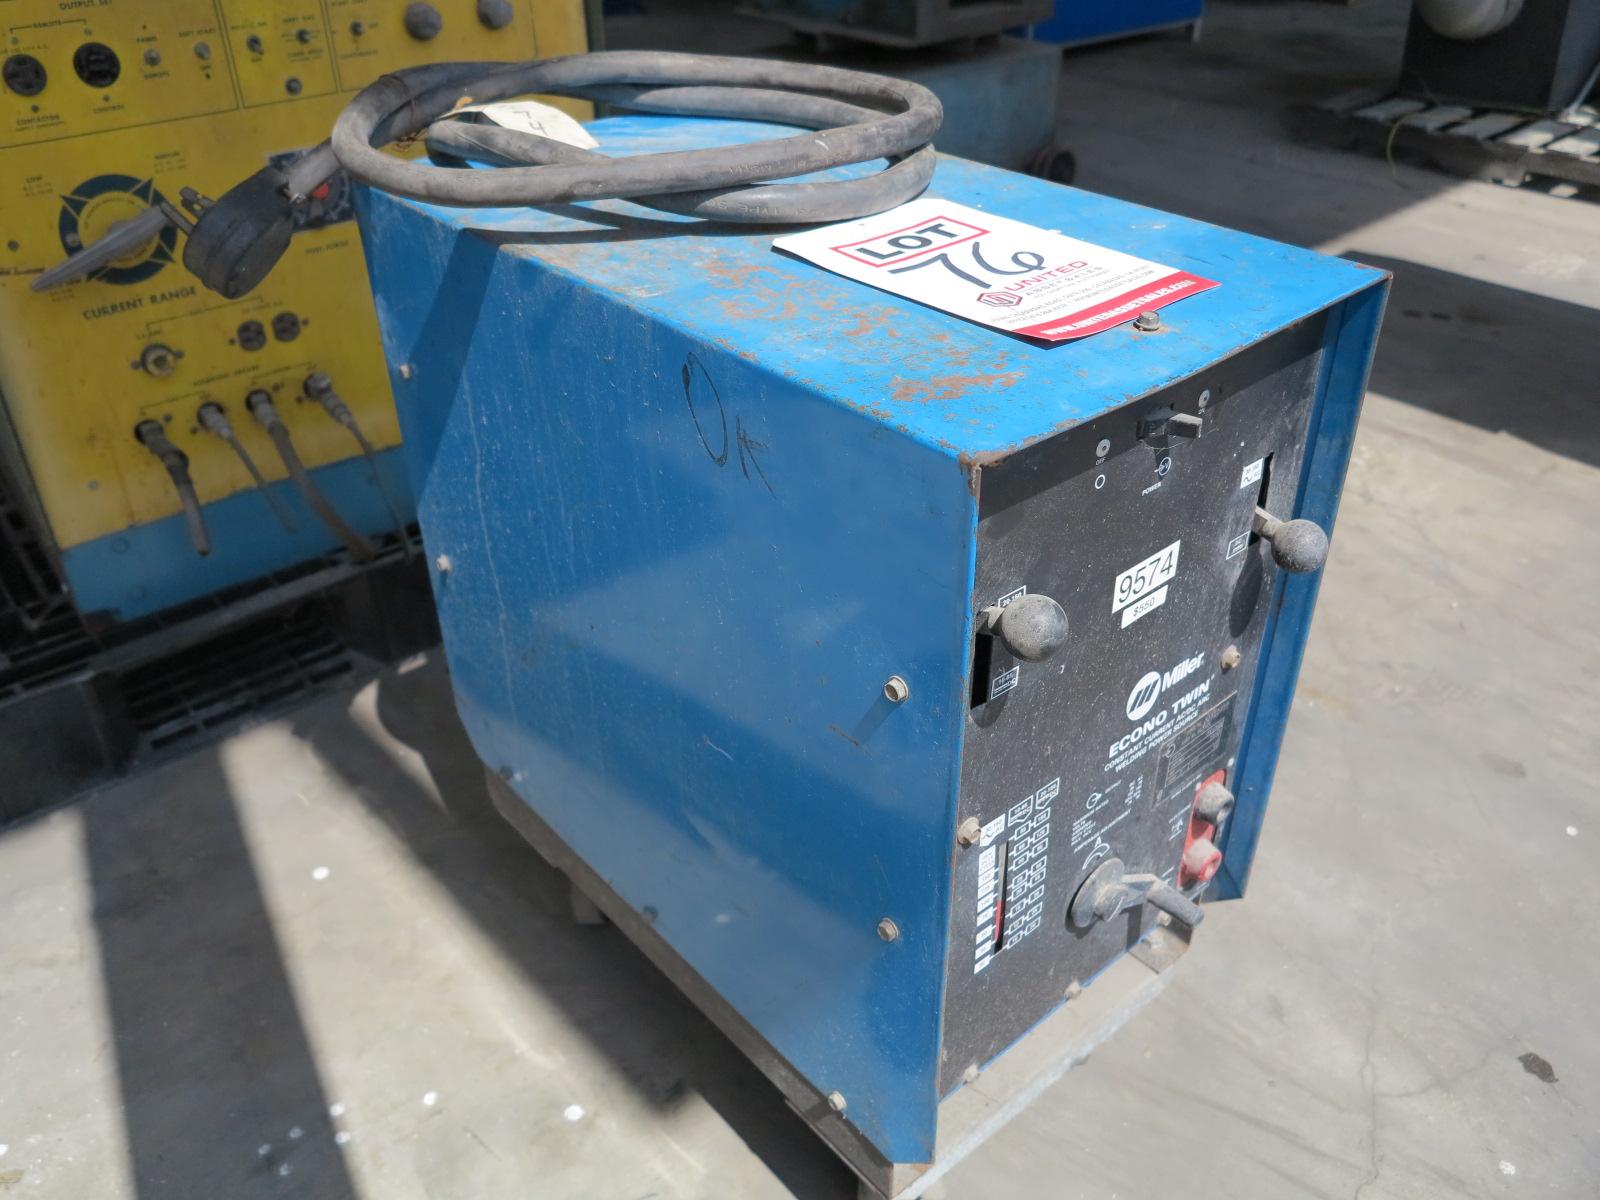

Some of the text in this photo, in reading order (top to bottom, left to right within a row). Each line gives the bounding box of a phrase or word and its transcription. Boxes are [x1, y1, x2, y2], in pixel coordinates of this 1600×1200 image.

[59, 0, 94, 10] OUTPUT
[854, 223, 959, 260] LOT
[887, 242, 1049, 289] 76
[1004, 261, 1088, 292] UNITED
[1026, 266, 1103, 296] ASSET SALES
[82, 286, 196, 320] CURRENT RANGE
[1096, 458, 1106, 466] OFF
[1142, 482, 1162, 496] POWER
[1119, 550, 1173, 604] 9574
[1133, 597, 1156, 617] $550
[1162, 652, 1205, 692] Miller
[1104, 694, 1210, 772] CONSTANT CURRENT AC/DC ARC
[1109, 709, 1167, 758] ECONO
[1171, 680, 1210, 714] TWIN
[1115, 712, 1199, 773] WELDING POWER SOURCE
[1101, 808, 1131, 834] ADJUSTMENT
